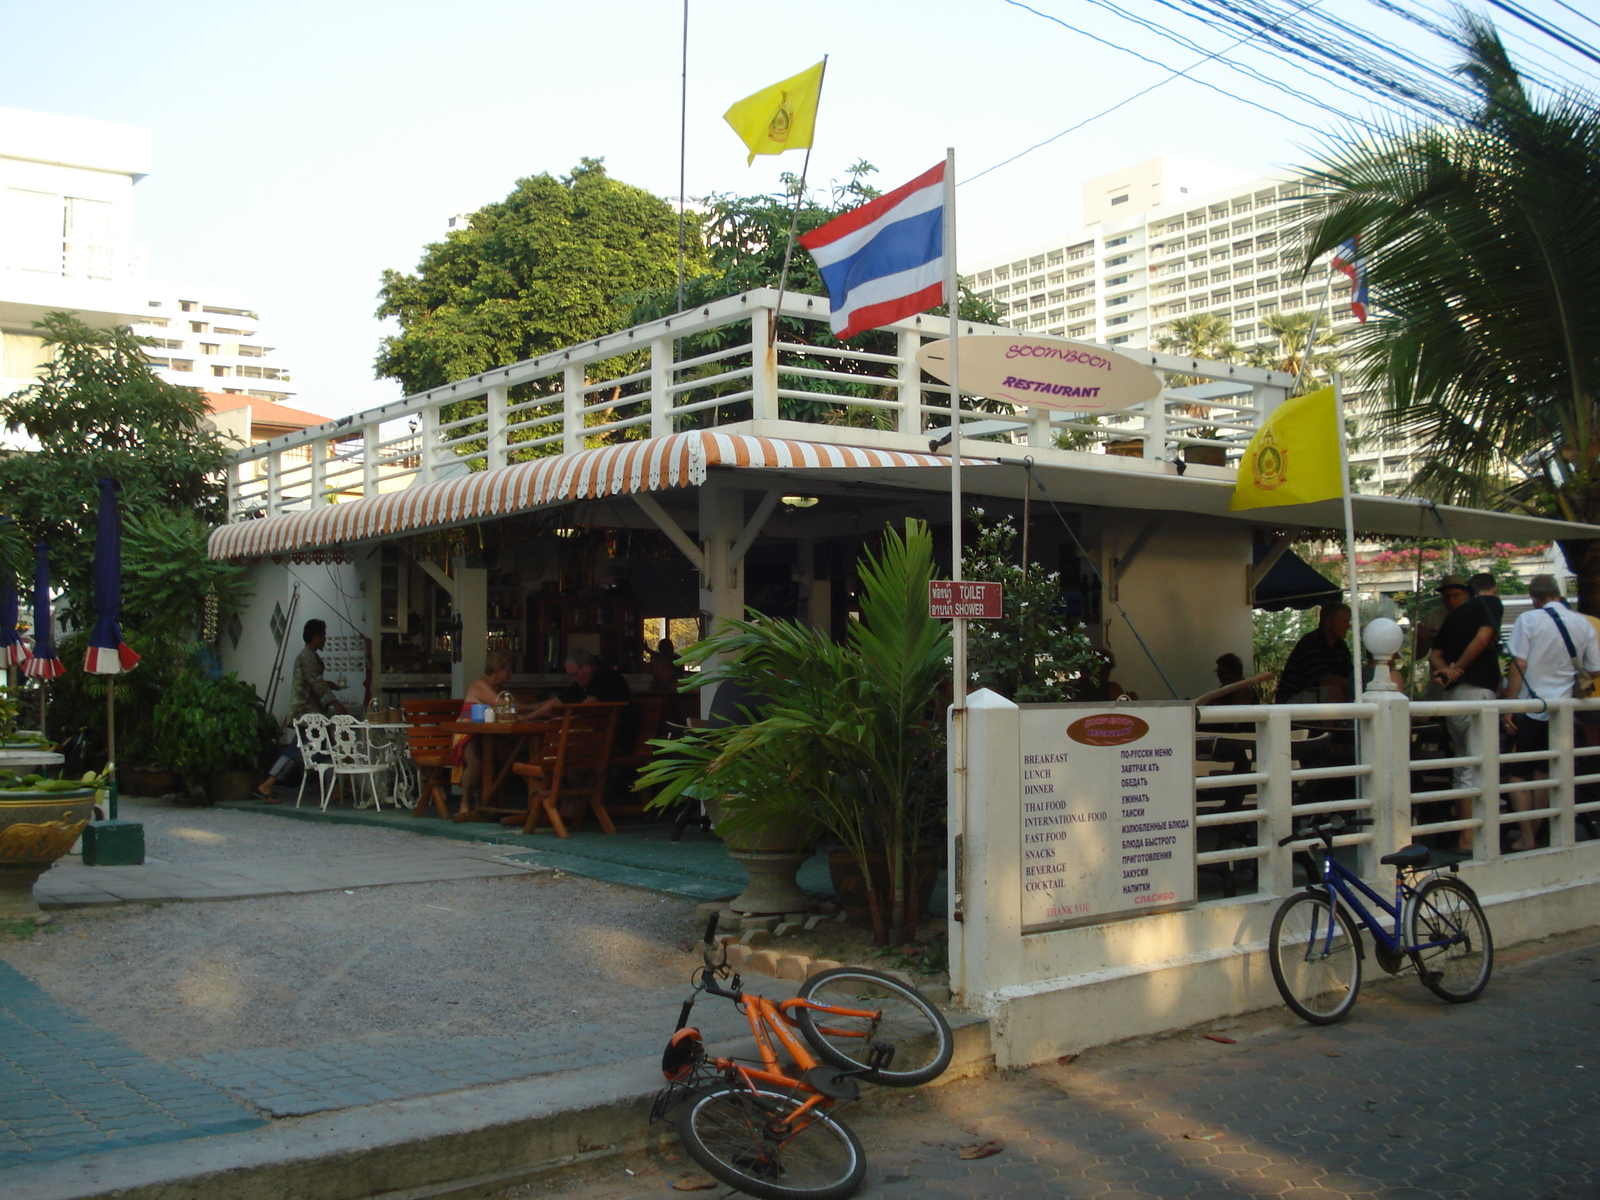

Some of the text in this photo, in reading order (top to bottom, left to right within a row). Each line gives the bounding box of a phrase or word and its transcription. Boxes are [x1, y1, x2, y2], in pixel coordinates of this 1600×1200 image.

[1002, 376, 1101, 397] RESTAURANT
[959, 585, 986, 600] TOILET
[954, 602, 985, 615] SHOWER
[1024, 753, 1068, 765] BREAKFAST
[1121, 748, 1173, 759] ПО-РУССКИ МЕНЮ
[1024, 769, 1051, 780] LUNCH
[1121, 764, 1147, 774] ЗАВТРАК
[1121, 777, 1148, 788] ОБЕДАТЬ
[1024, 784, 1054, 795] DINNER
[1121, 794, 1150, 805] УЖИНАТЬ
[1025, 800, 1067, 813] THAI FOOD
[1025, 811, 1107, 828] INTERNATIONAL FOOD
[1122, 819, 1189, 834] ИЗЛЮБЛЕННЫЕ БЛЮДА
[1025, 831, 1067, 844] FAST FOOD
[1122, 836, 1177, 850] БЛЮДА БЫСТРОГО
[1025, 848, 1056, 860] SNACKS
[1122, 850, 1173, 865] ПРИГОТОВЛЕНИЯ
[1025, 863, 1067, 877] BEVERAGE
[1122, 868, 1149, 879] ЗАКУСКИ
[1025, 878, 1065, 892] COCKTAIL
[1122, 882, 1151, 894] НАПИТКИ
[1134, 892, 1175, 905] СПАСИБО
[1046, 903, 1090, 918] THANK YOU
